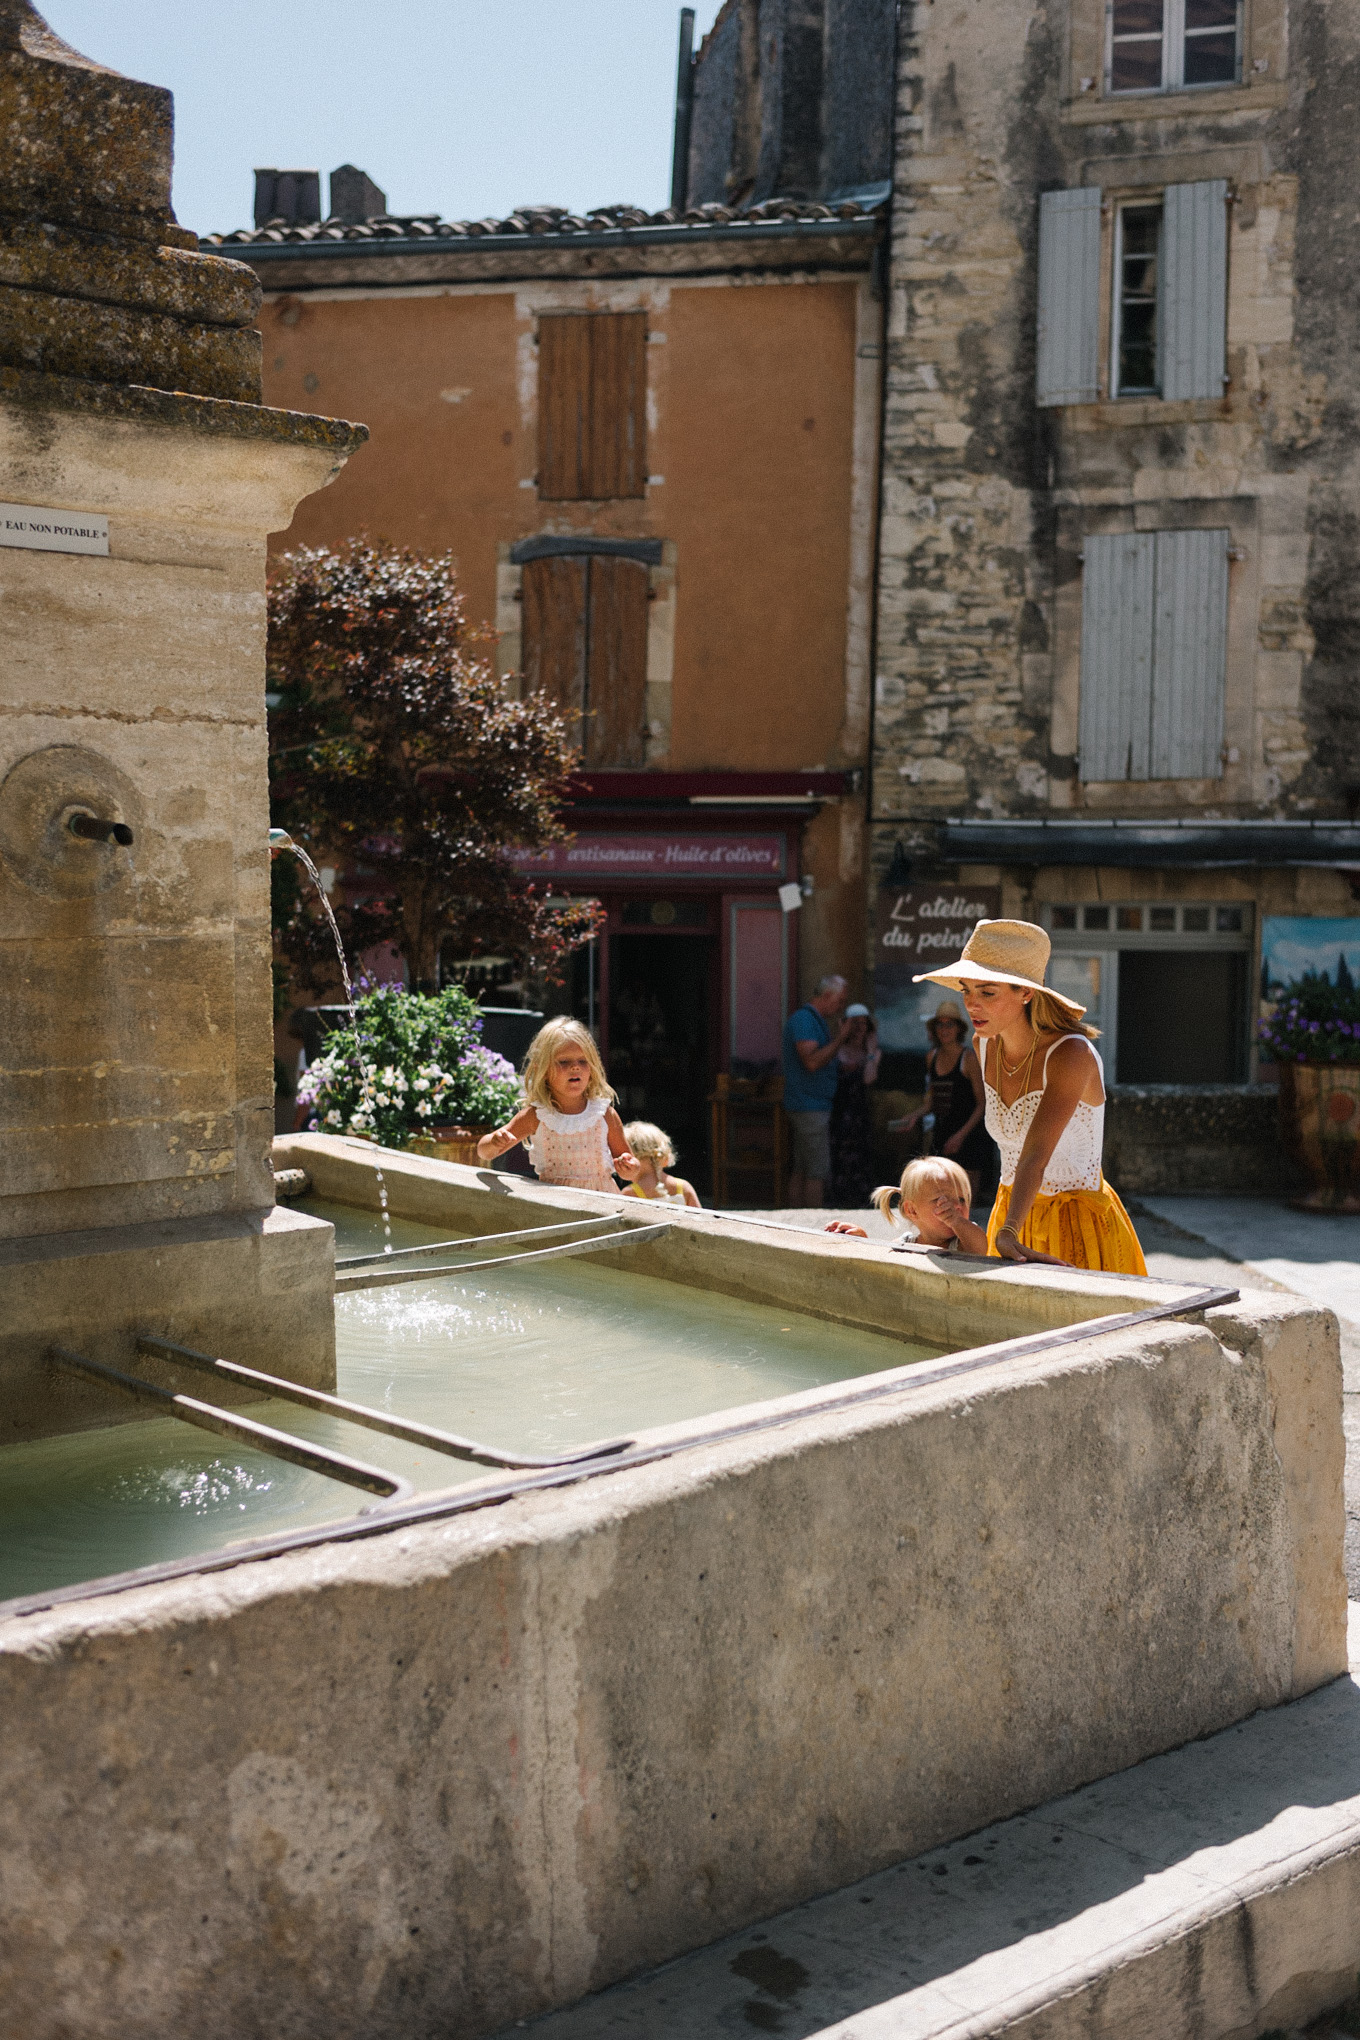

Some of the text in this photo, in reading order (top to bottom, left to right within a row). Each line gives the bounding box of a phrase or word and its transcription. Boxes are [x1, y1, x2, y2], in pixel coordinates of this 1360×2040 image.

[5, 520, 100, 538] EAU NON POTABLE
[567, 845, 655, 861] artisanaux
[665, 845, 708, 864] Huile
[709, 845, 771, 862] d'olives
[882, 925, 914, 947] du
